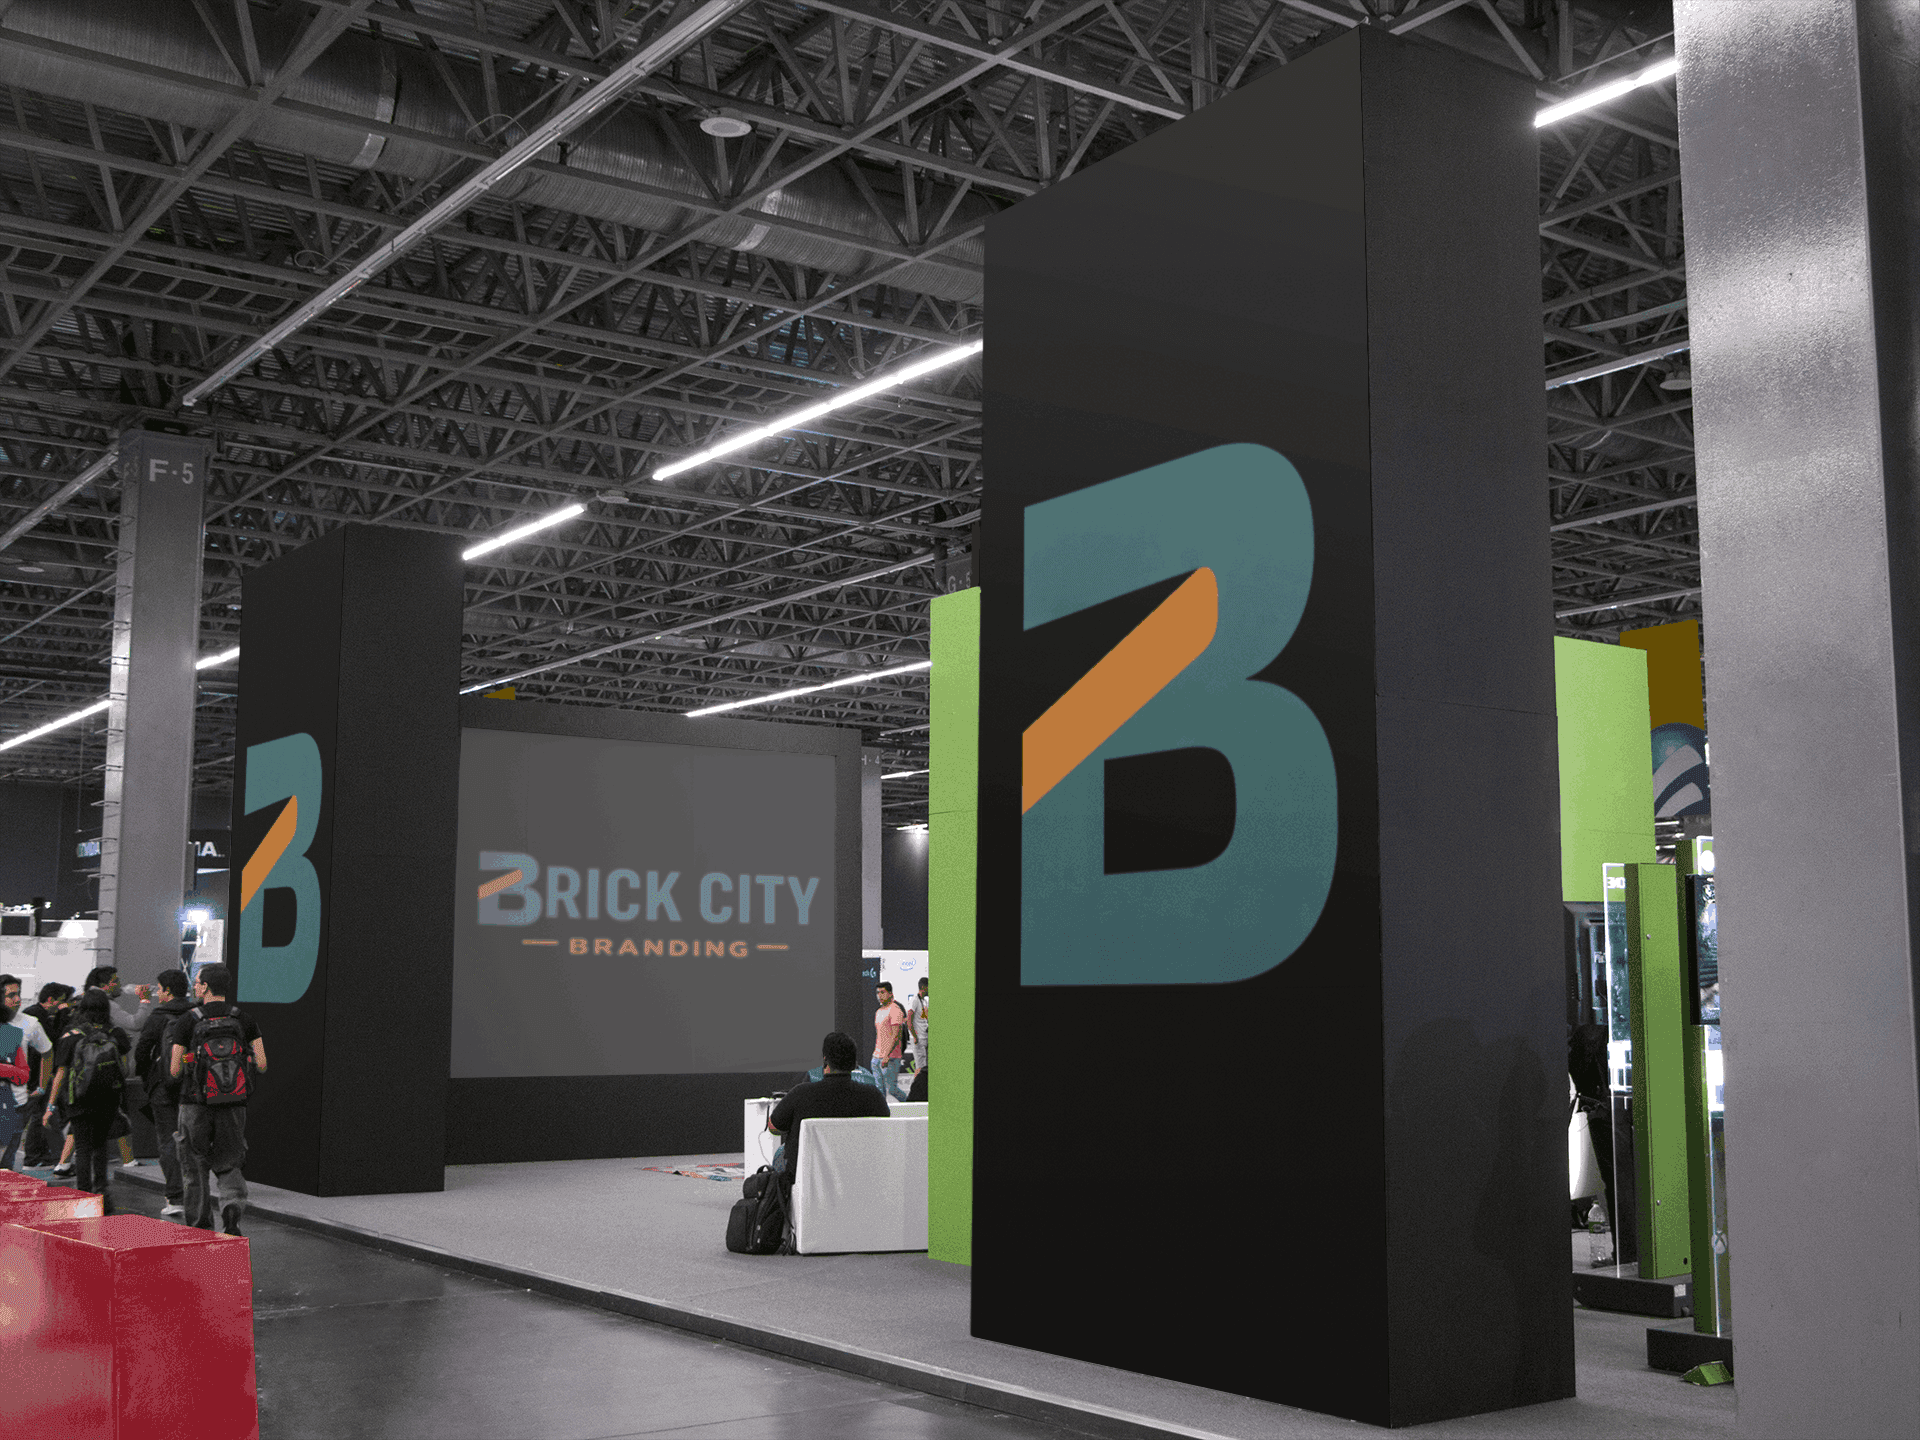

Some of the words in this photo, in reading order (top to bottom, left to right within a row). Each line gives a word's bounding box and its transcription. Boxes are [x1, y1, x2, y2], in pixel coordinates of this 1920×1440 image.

[1021, 443, 1339, 986] B
[237, 733, 323, 1003] B
[477, 850, 681, 926] BRICK
[699, 872, 820, 925] CITY
[569, 937, 749, 958] BRANDING
